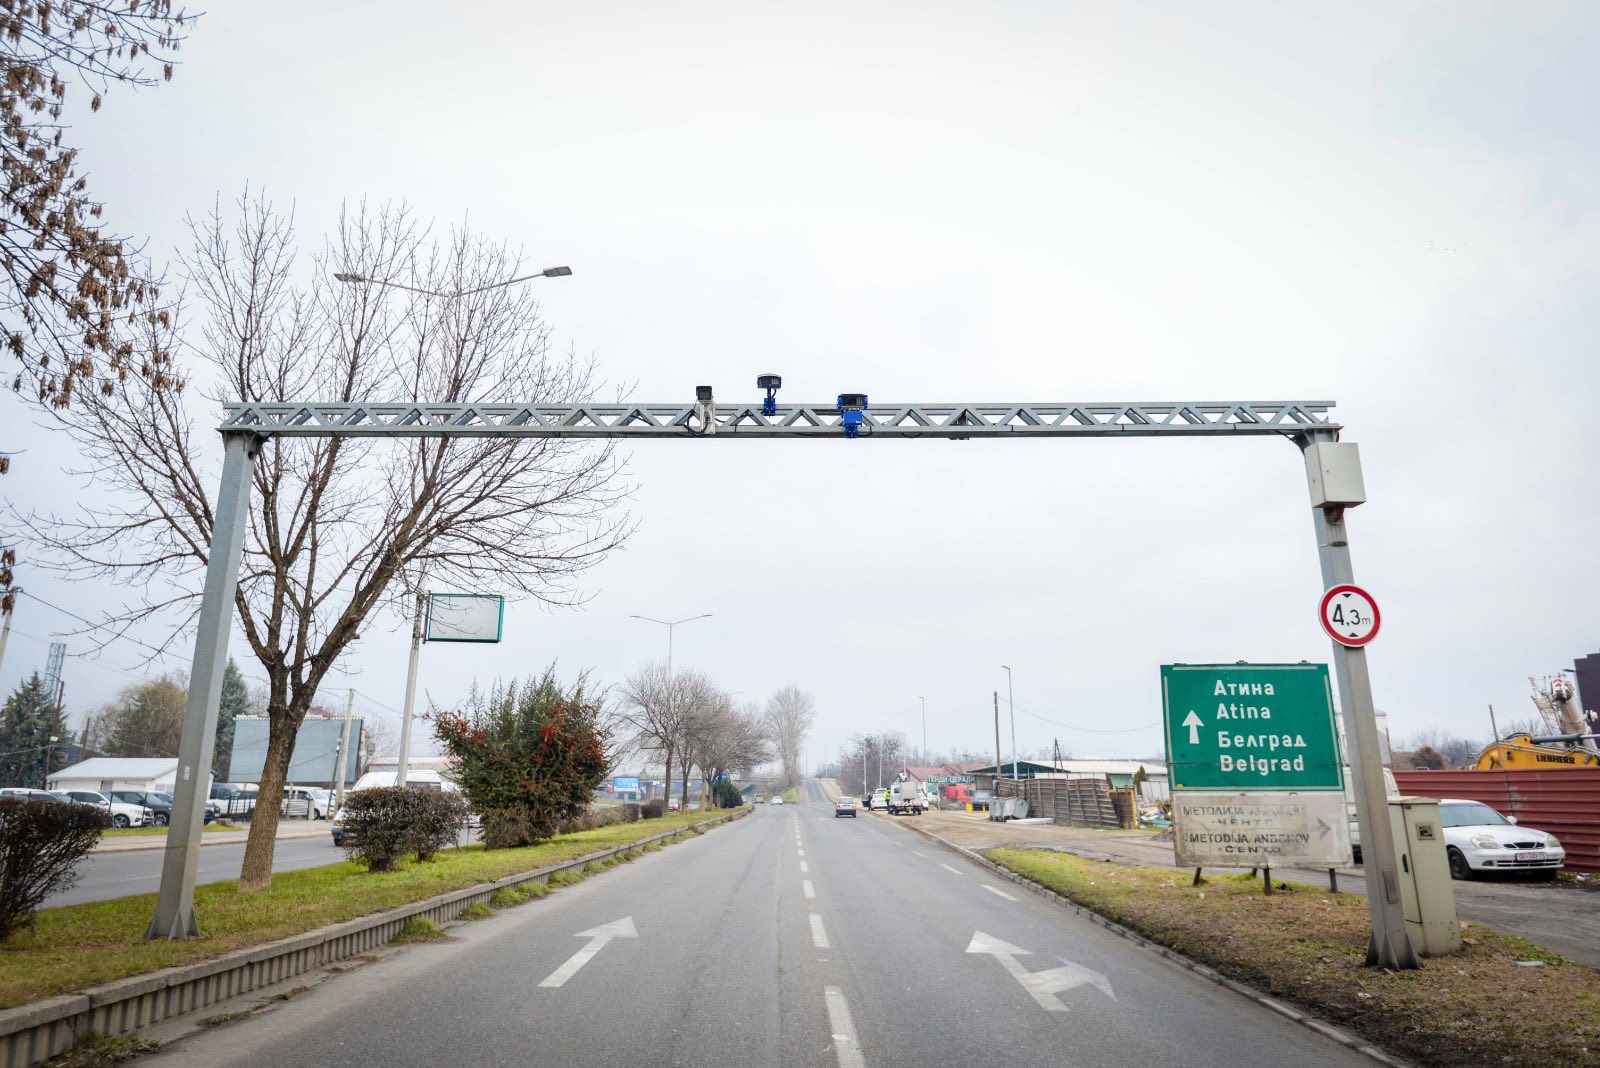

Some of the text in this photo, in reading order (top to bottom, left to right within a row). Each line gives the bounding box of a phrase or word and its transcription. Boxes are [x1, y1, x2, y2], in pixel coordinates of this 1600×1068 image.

[1213, 679, 1275, 696] Атина
[1216, 702, 1271, 720] Atina
[1217, 731, 1307, 751] Белград
[1219, 754, 1305, 776] Belgrad
[1536, 755, 1575, 764] LIEBHERR
